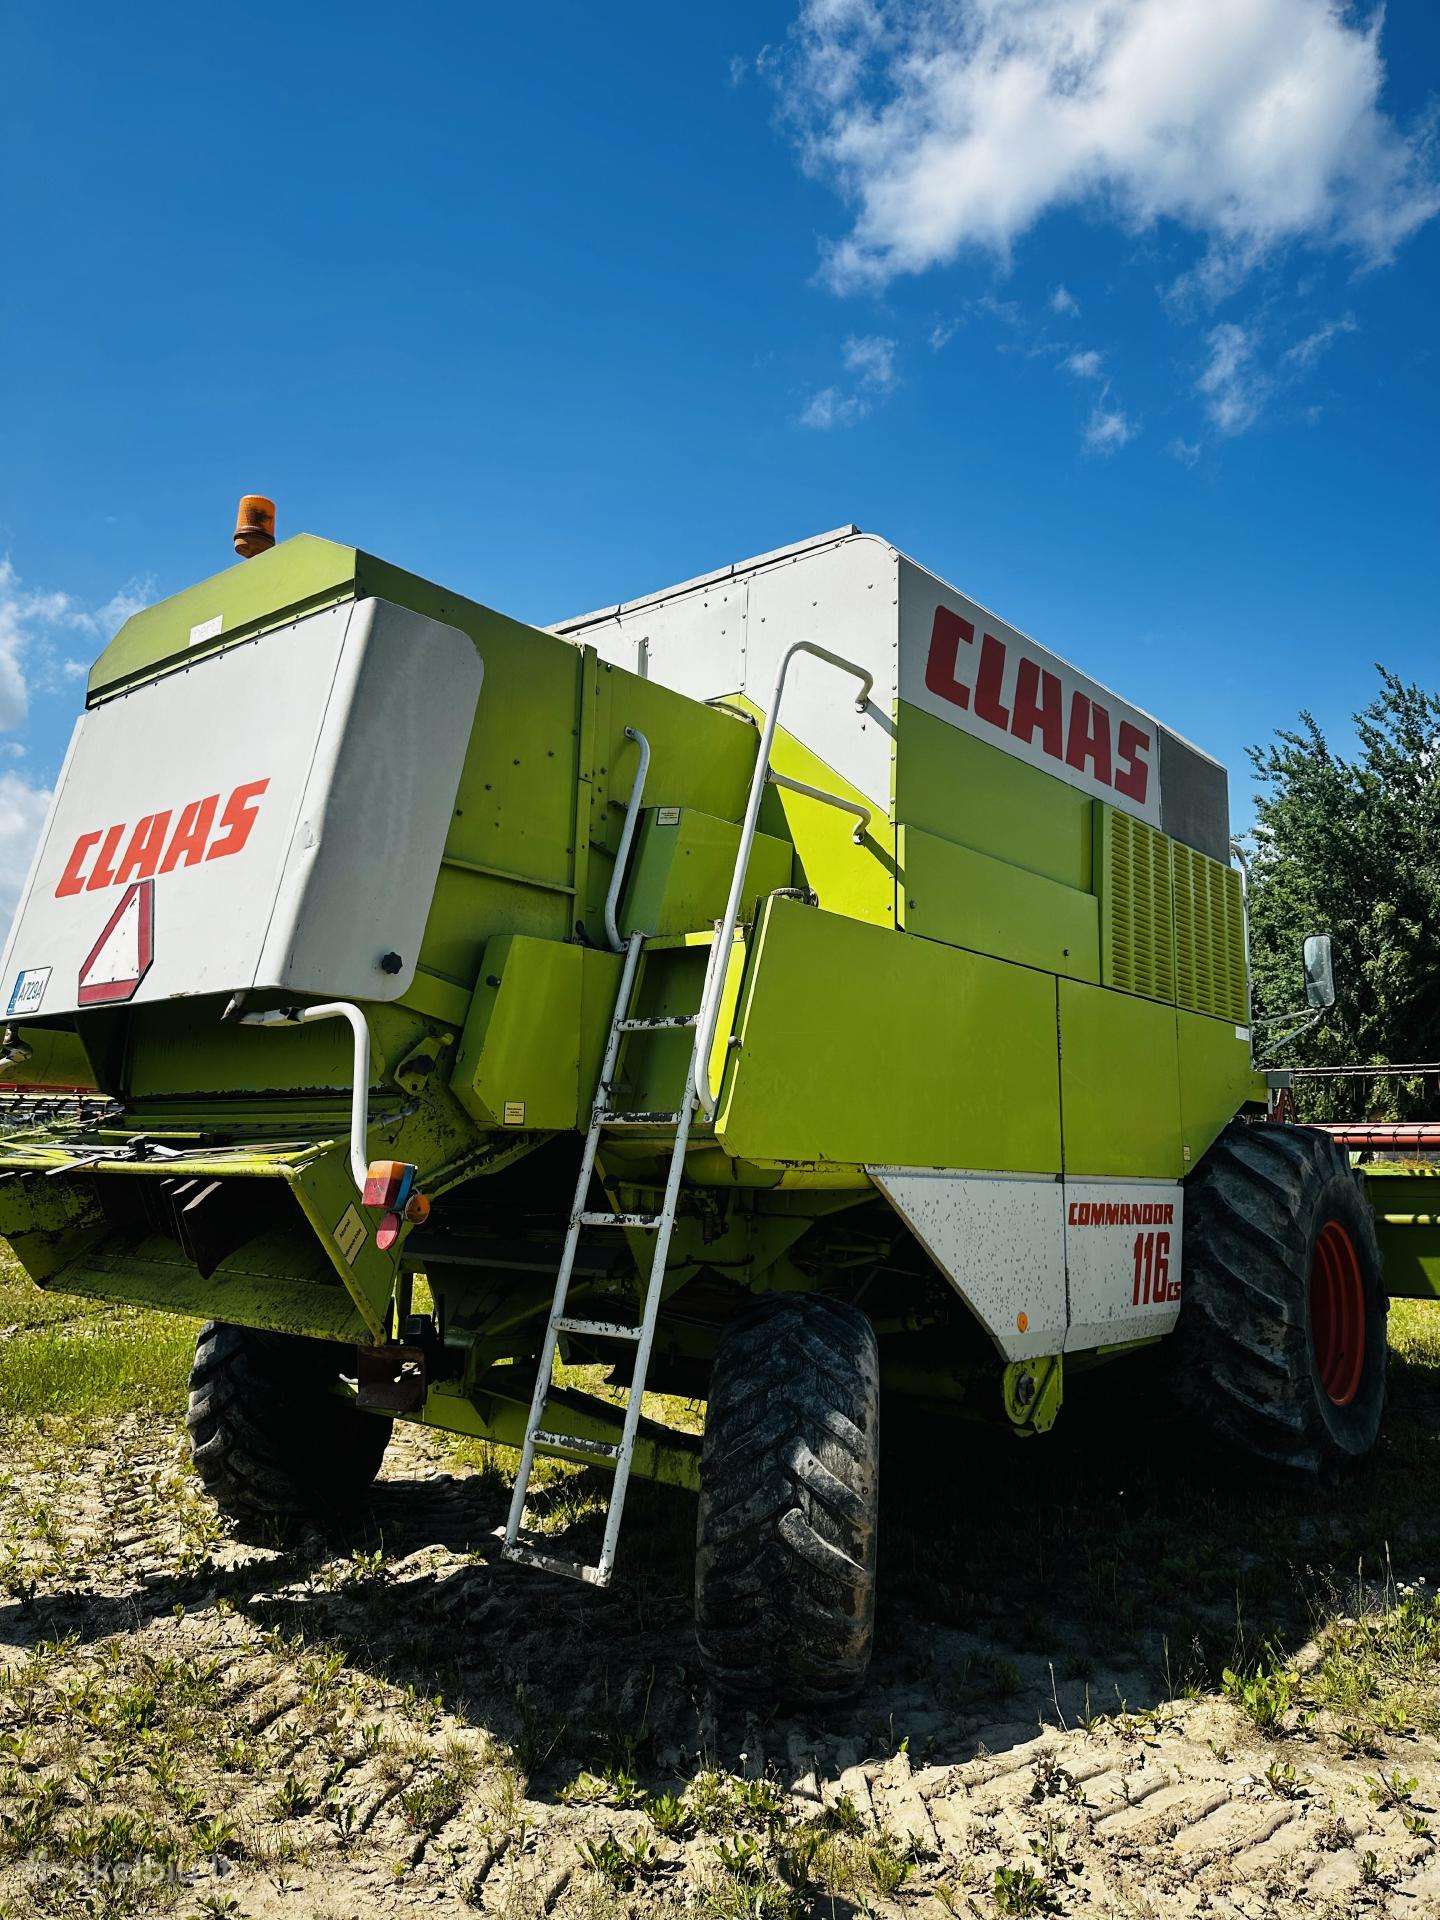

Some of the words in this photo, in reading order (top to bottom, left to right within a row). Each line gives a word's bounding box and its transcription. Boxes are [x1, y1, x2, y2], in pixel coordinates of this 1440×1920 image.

[925, 605, 1150, 804] CLAAS
[55, 778, 271, 898] CLAAS
[1068, 1203, 1174, 1226] COMMANDOR
